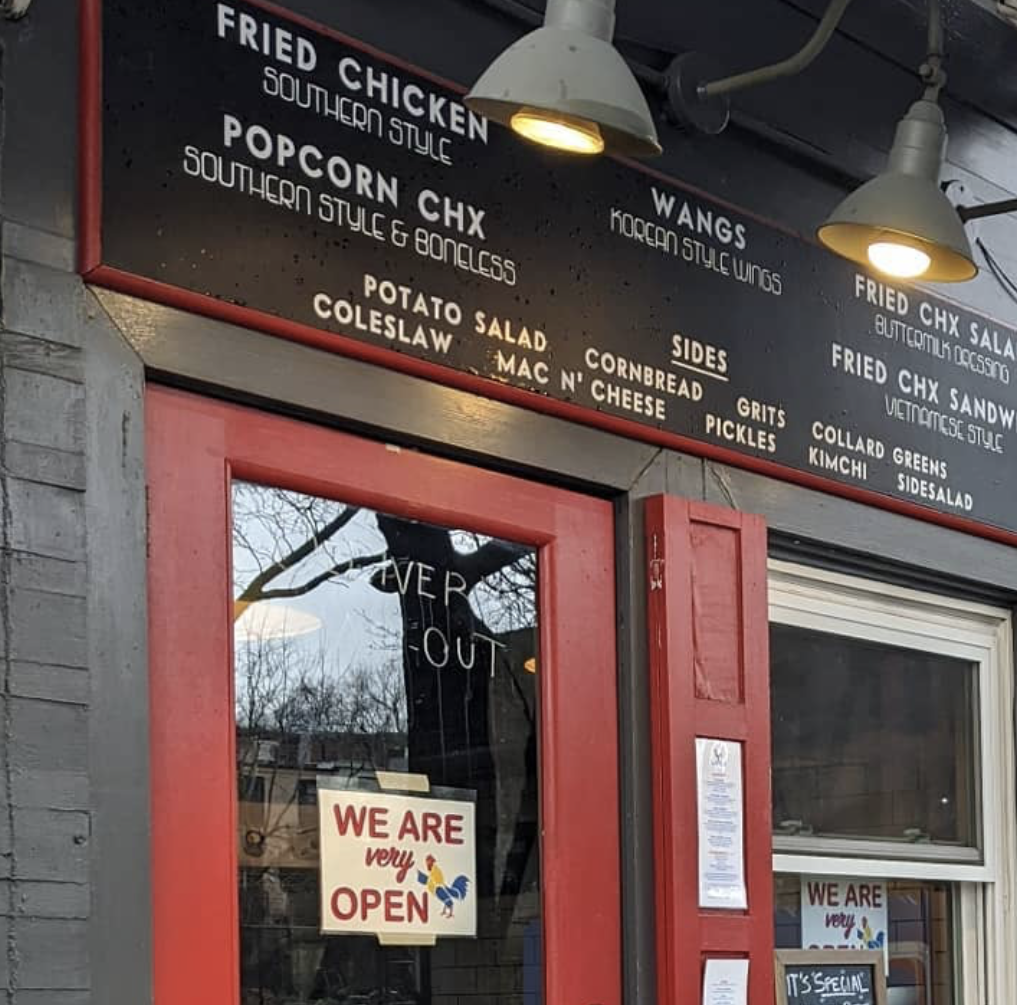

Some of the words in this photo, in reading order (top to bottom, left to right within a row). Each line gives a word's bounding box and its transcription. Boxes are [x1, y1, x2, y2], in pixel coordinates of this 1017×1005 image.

[216, 3, 317, 72] FRIED
[338, 57, 488, 145] CHICKEN
[262, 66, 382, 138] SOUTHERN
[389, 117, 453, 166] STYLE
[223, 114, 398, 208] POPCORN
[417, 189, 486, 240] CHX
[183, 145, 311, 216] SOUTHERN
[318, 193, 385, 241] STYLE
[391, 220, 409, 248] &
[415, 226, 516, 285] BONELESS
[651, 187, 747, 250] WANGS
[610, 208, 678, 256] KOREAN
[682, 238, 730, 276] STYLE
[733, 258, 782, 295] WINGS
[314, 293, 452, 354] COLESLAW
[364, 274, 461, 325] POTATO
[475, 310, 547, 351] SALAD
[855, 274, 908, 315] FRIED
[919, 302, 960, 337] CHX
[585, 347, 703, 401] CORNBREAD
[672, 335, 728, 373] SIDES
[832, 343, 887, 384] FRIED
[899, 368, 939, 404] CHX
[875, 314, 950, 363] BUTTERMILK
[954, 348, 1010, 384] DRESSING
[498, 350, 548, 384] MAC
[561, 369, 583, 393] N'
[591, 379, 665, 420] CHEESE
[736, 396, 786, 429] GRITS
[706, 413, 776, 453] PICKLES
[812, 421, 884, 459] COLLARD
[893, 447, 947, 480] GREENS
[885, 396, 964, 439] VIETNAMESE
[967, 424, 1003, 454] STYLE
[809, 446, 867, 480] KIMCHI
[897, 473, 973, 511] SIDESALAD
[333, 803, 389, 838] WE
[398, 810, 464, 845] ARE
[364, 846, 415, 884] very
[807, 881, 839, 907] WE
[844, 881, 882, 908] ARE
[330, 887, 429, 924] OPEN
[825, 912, 856, 939] very
